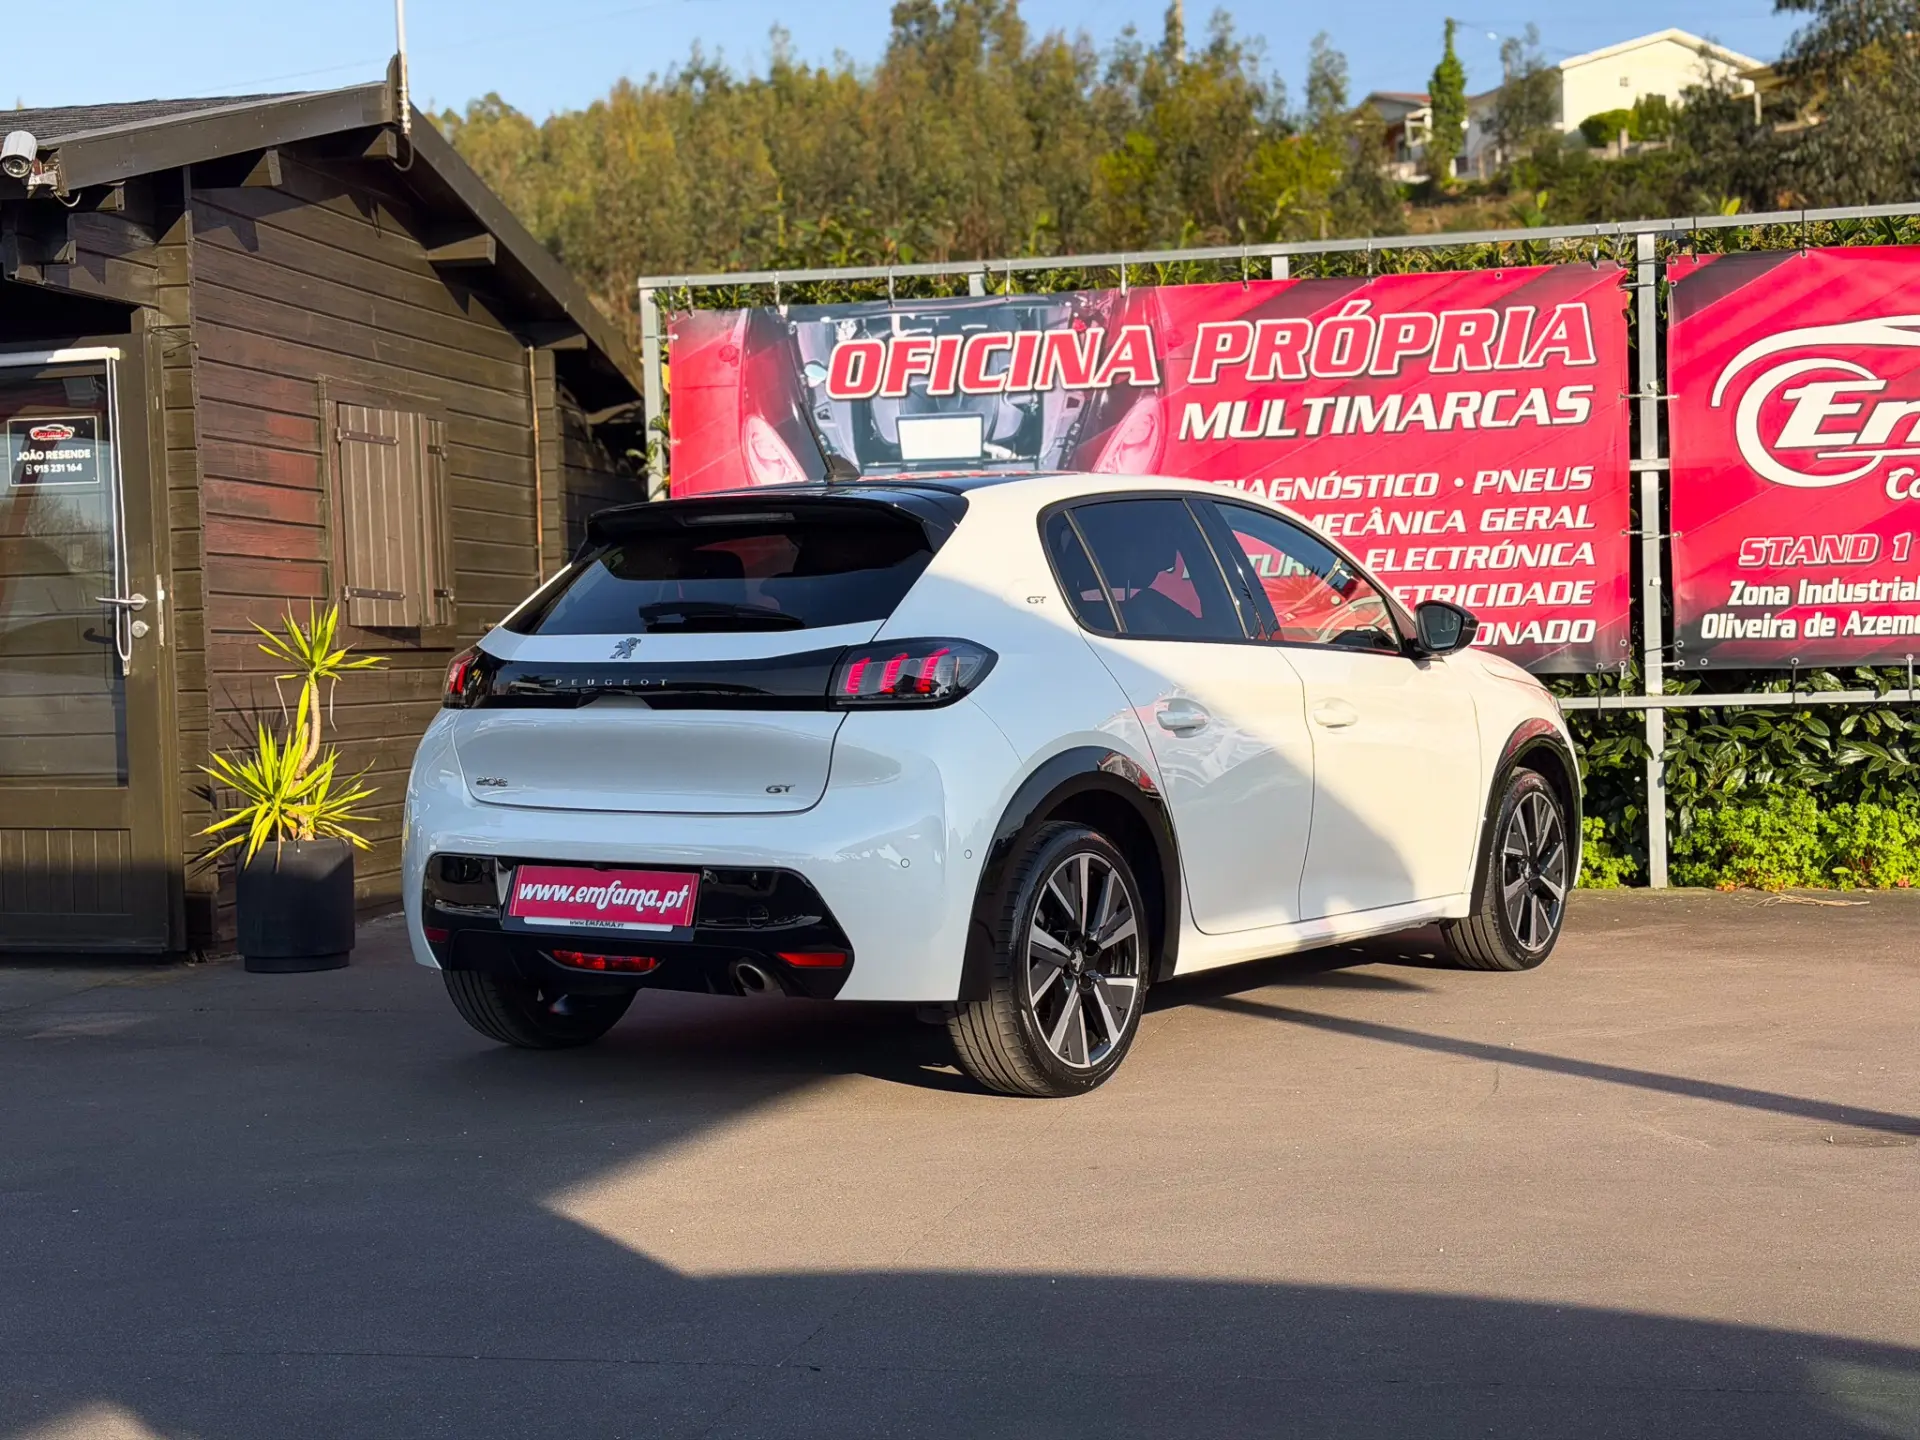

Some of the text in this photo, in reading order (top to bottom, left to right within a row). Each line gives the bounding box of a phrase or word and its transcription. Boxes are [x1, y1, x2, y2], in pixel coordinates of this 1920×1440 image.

[825, 299, 1597, 399] OFICINA PRÓPRIA
[1178, 385, 1595, 441] MULTIMARCAS
[17, 449, 91, 461] JOÃO RESENDE
[1473, 466, 1594, 494] PNEUS
[1480, 505, 1595, 532] GERAL
[1365, 540, 1595, 572] ELECTRÓNICA
[1738, 532, 1911, 567] STAND 1
[1026, 595, 1047, 604] GT
[1727, 575, 1920, 605] Zona Industrial
[1701, 612, 1797, 639] Oliveira
[1804, 611, 1836, 637] de
[555, 678, 668, 687] PEUGEOT
[476, 775, 508, 787] 208
[765, 784, 795, 794] GT
[519, 880, 689, 914] www.emfama.pt
